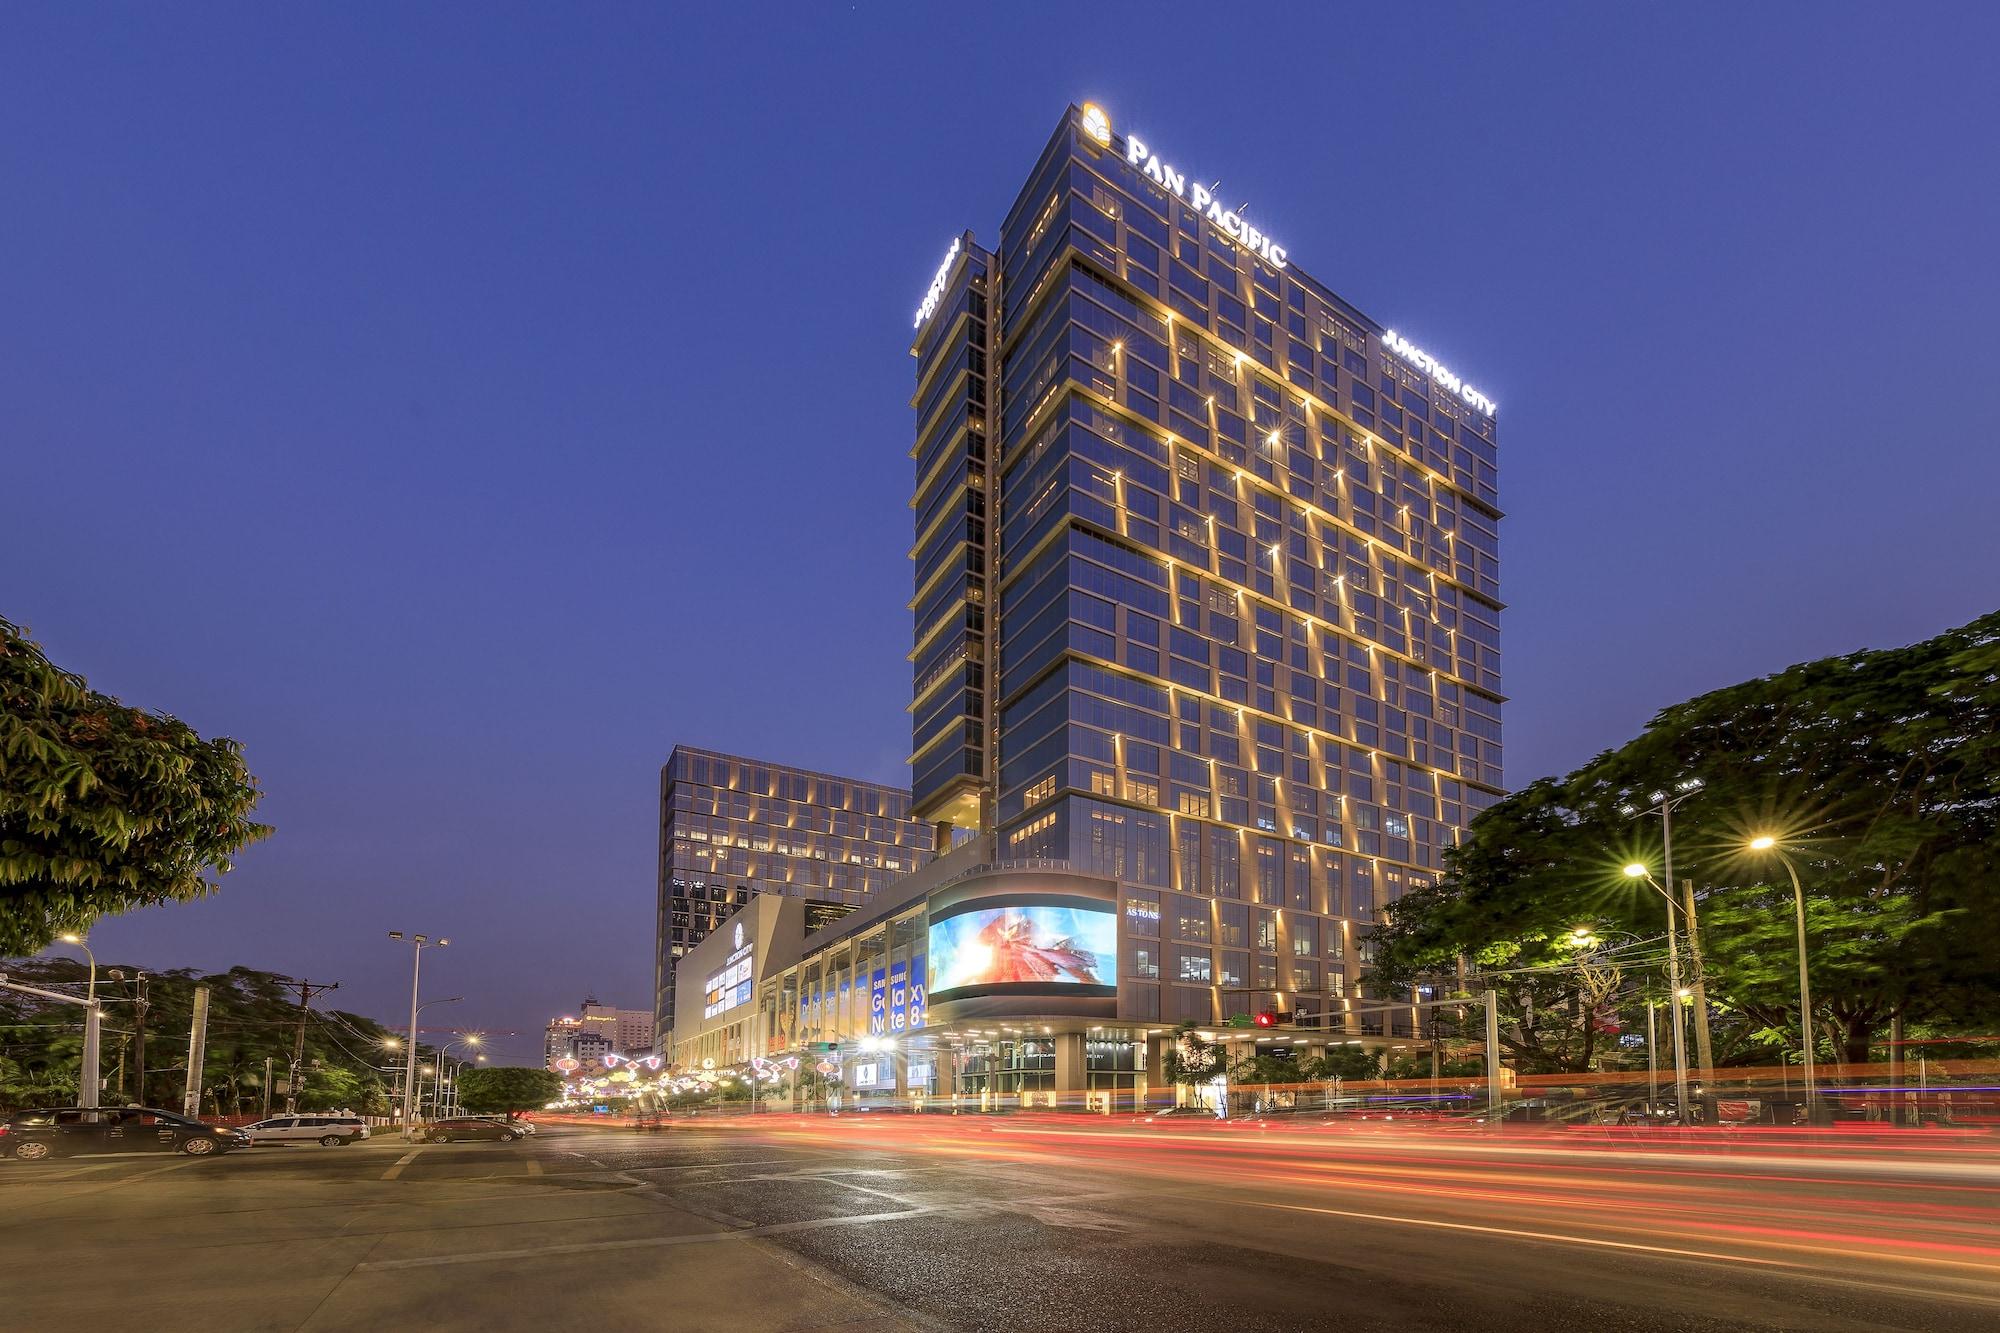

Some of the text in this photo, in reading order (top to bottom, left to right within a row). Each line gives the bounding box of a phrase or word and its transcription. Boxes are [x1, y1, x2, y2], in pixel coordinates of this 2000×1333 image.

[1127, 135, 1287, 269] PAN PACIFIC
[1382, 329, 1496, 416] JUNCTION CITY
[1126, 908, 1159, 919] ASTONS
[872, 1005, 920, 1034] Nte 8
